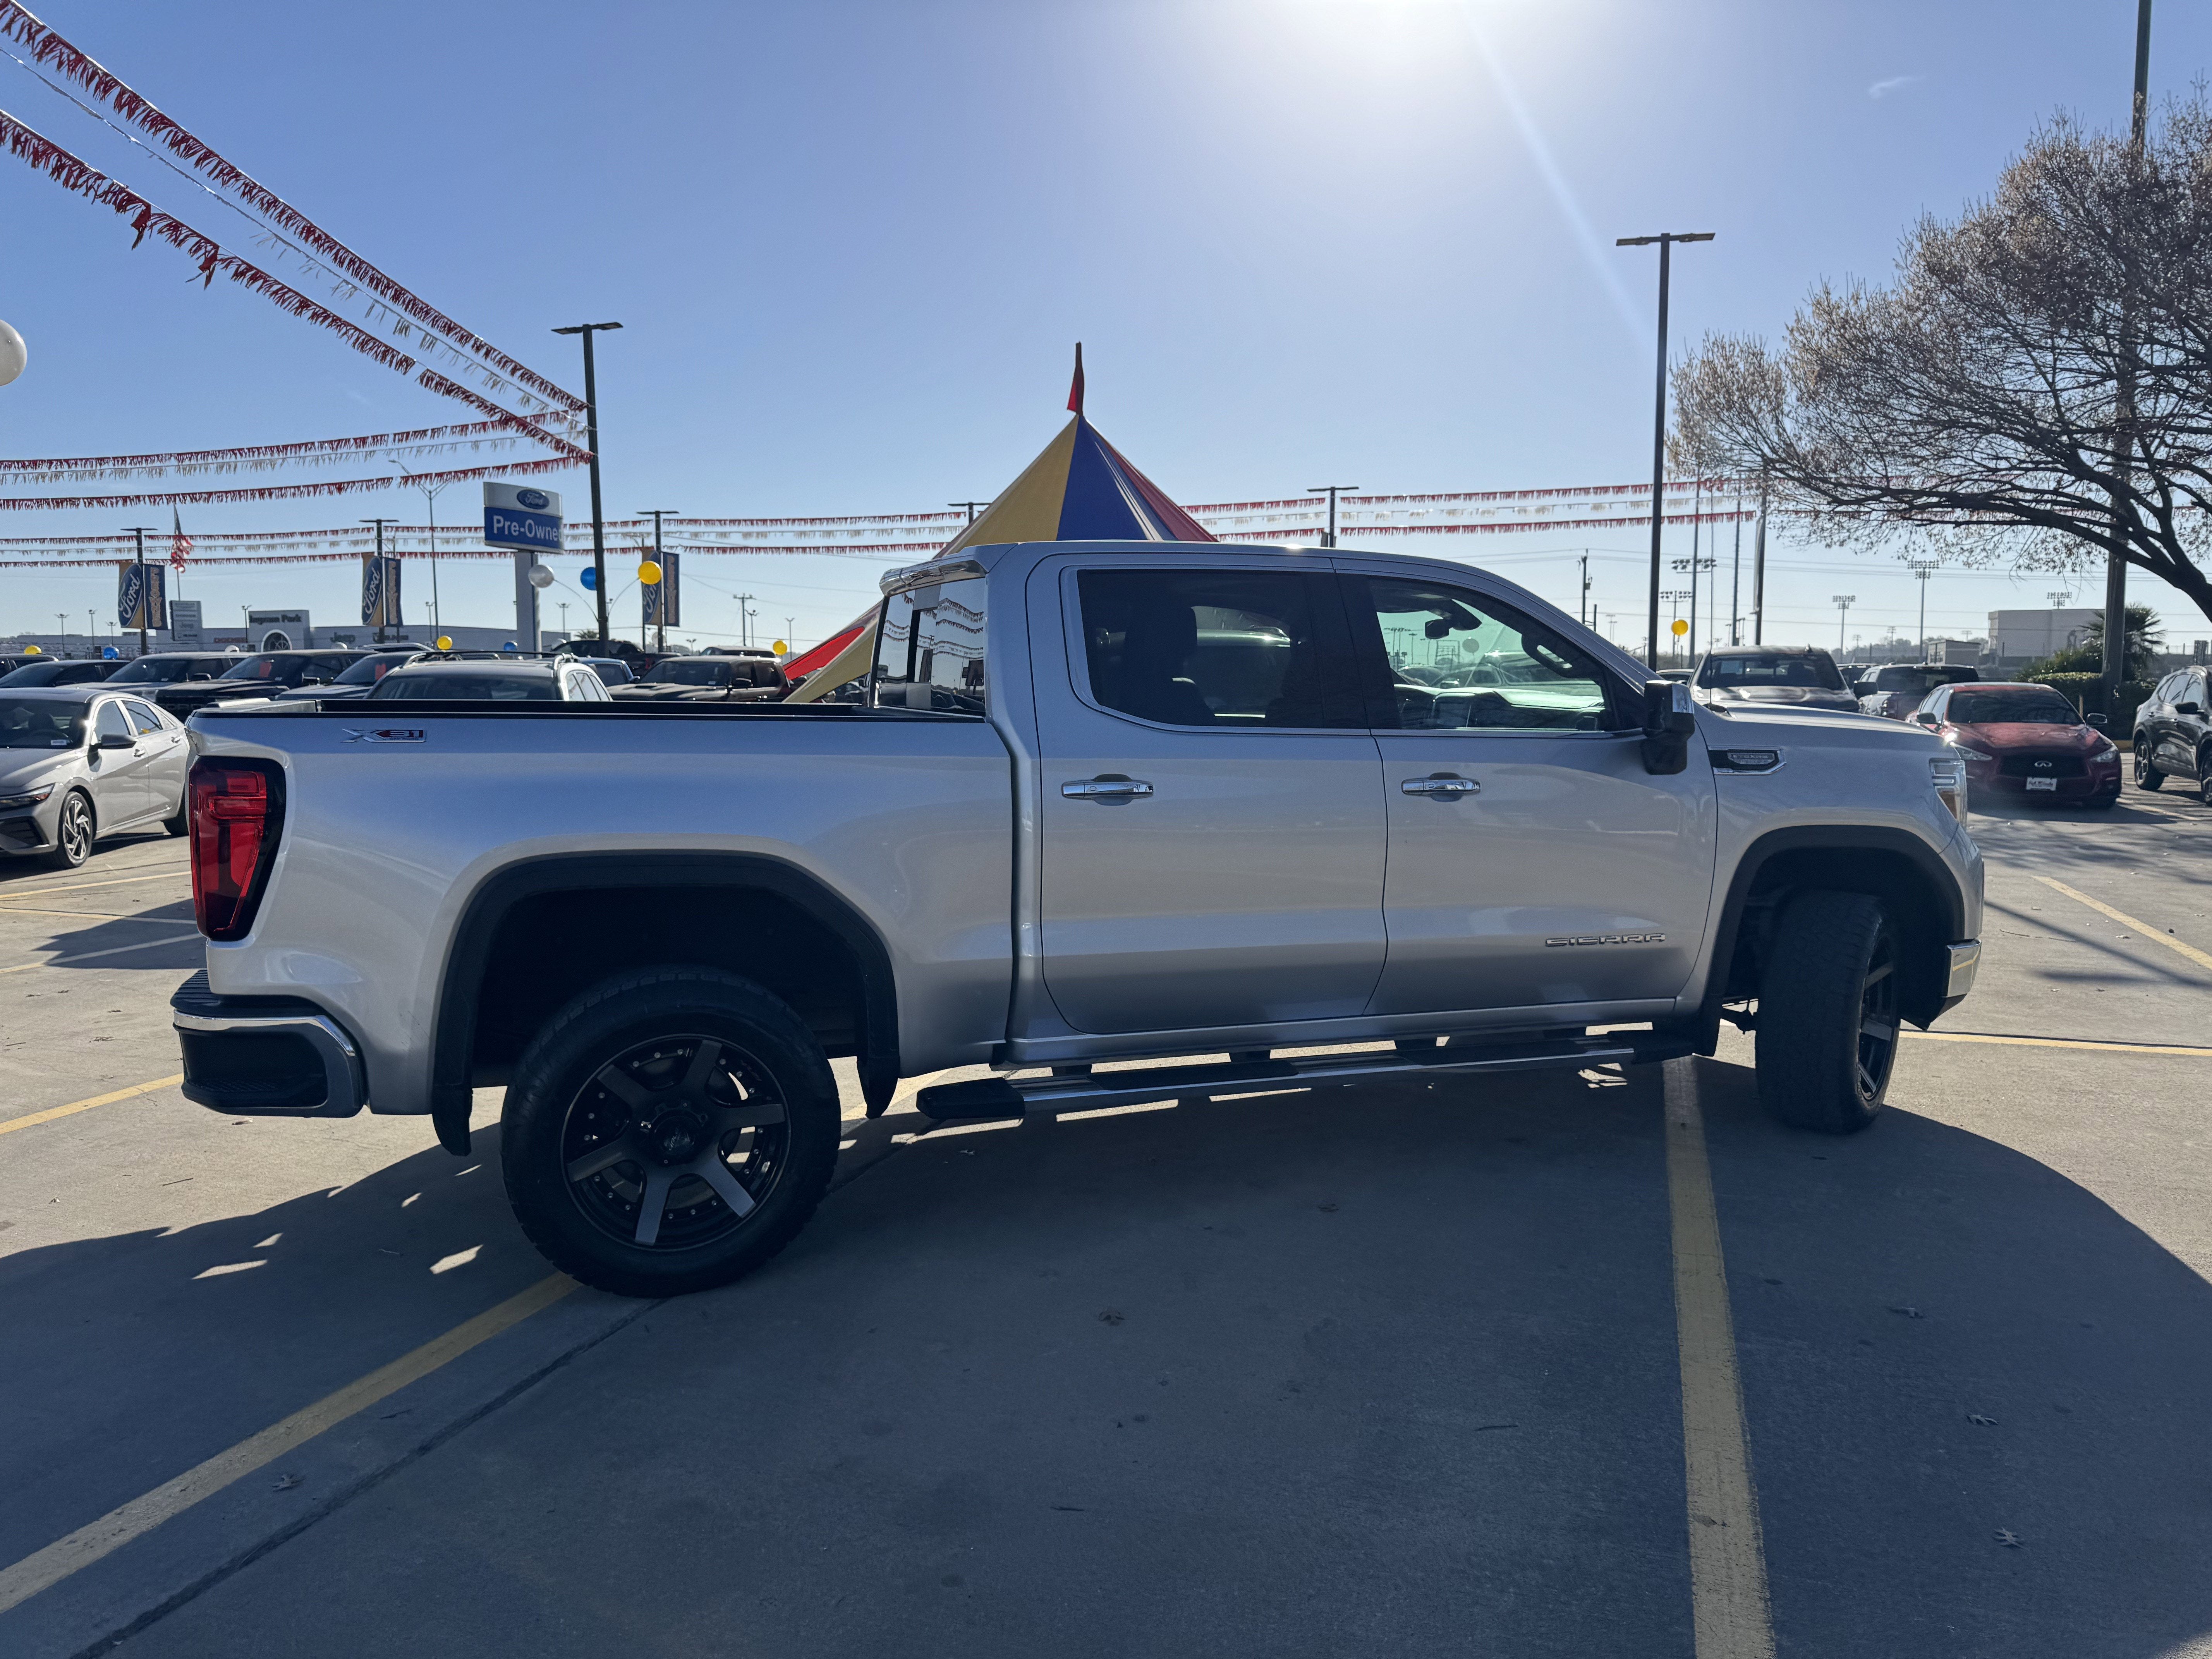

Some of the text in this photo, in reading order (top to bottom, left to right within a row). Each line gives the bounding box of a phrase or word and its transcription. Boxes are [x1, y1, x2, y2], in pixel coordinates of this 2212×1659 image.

[118, 573, 140, 618] Ford
[363, 567, 380, 614] Ford
[1546, 933, 1666, 946] SIERRA
